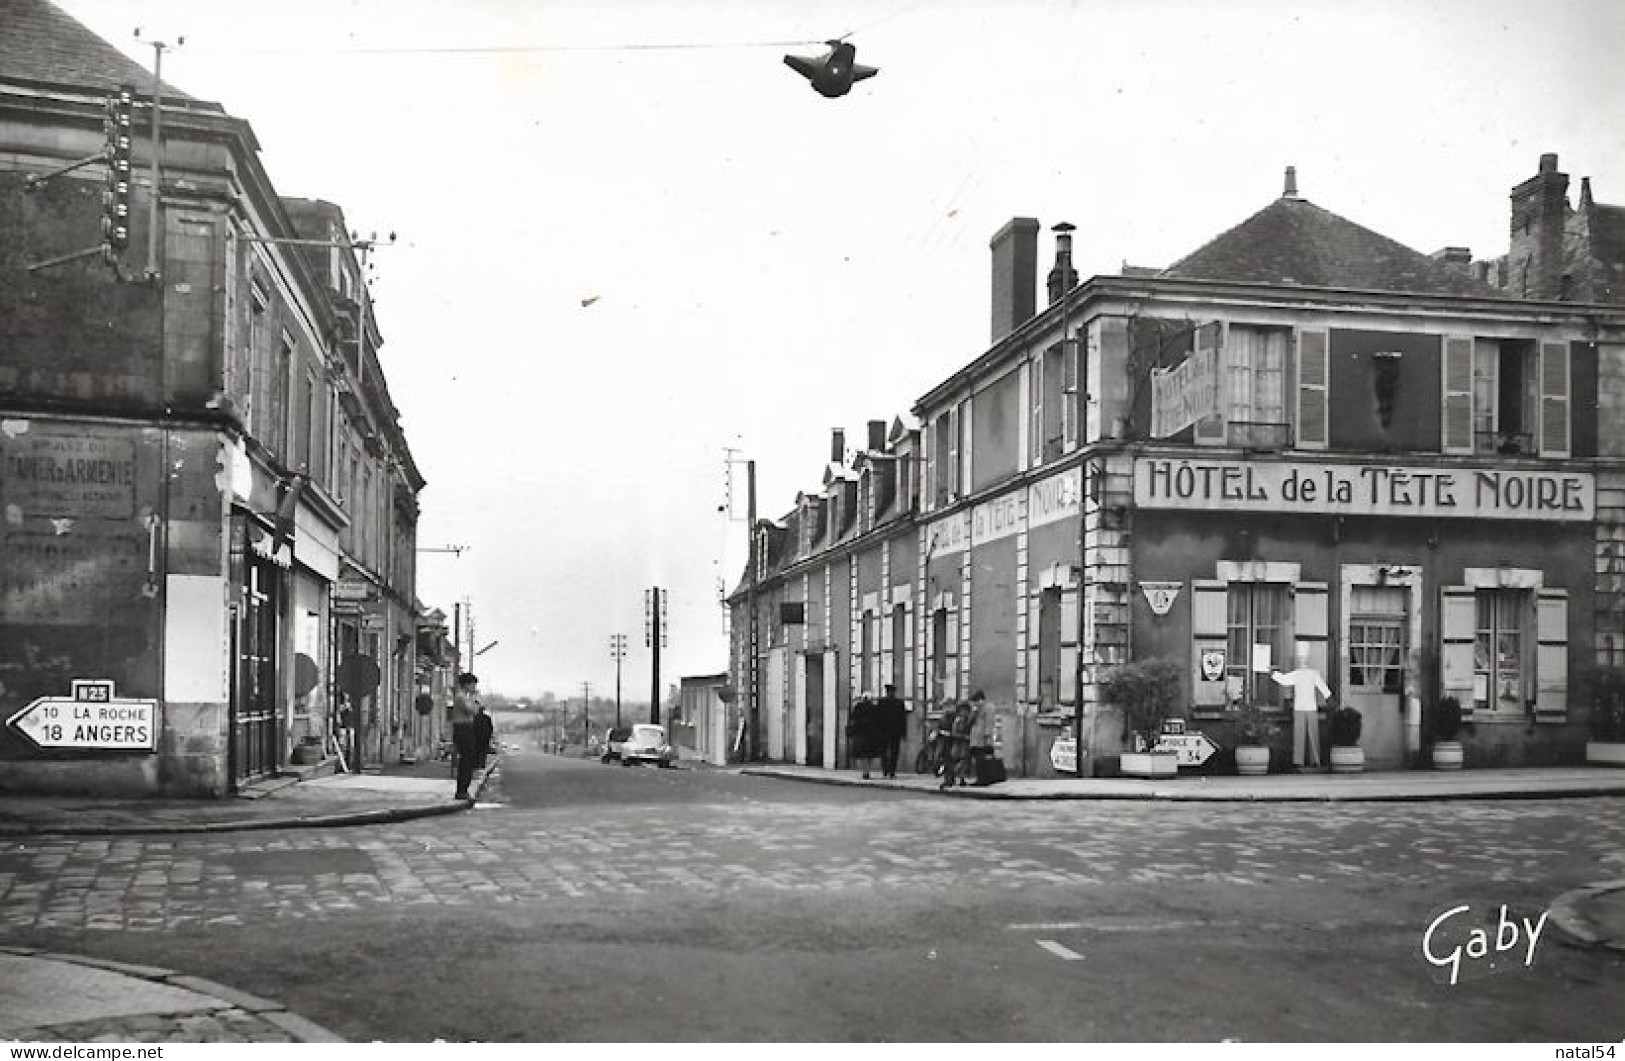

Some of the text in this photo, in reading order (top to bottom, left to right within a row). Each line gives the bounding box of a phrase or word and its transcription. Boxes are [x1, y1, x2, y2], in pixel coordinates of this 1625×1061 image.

[1149, 461, 1583, 511] HÔTEL de la TÊTE NOIRE
[43, 707, 147, 721] 10 LA ROCHE
[42, 725, 148, 743] 18 ANGERS
